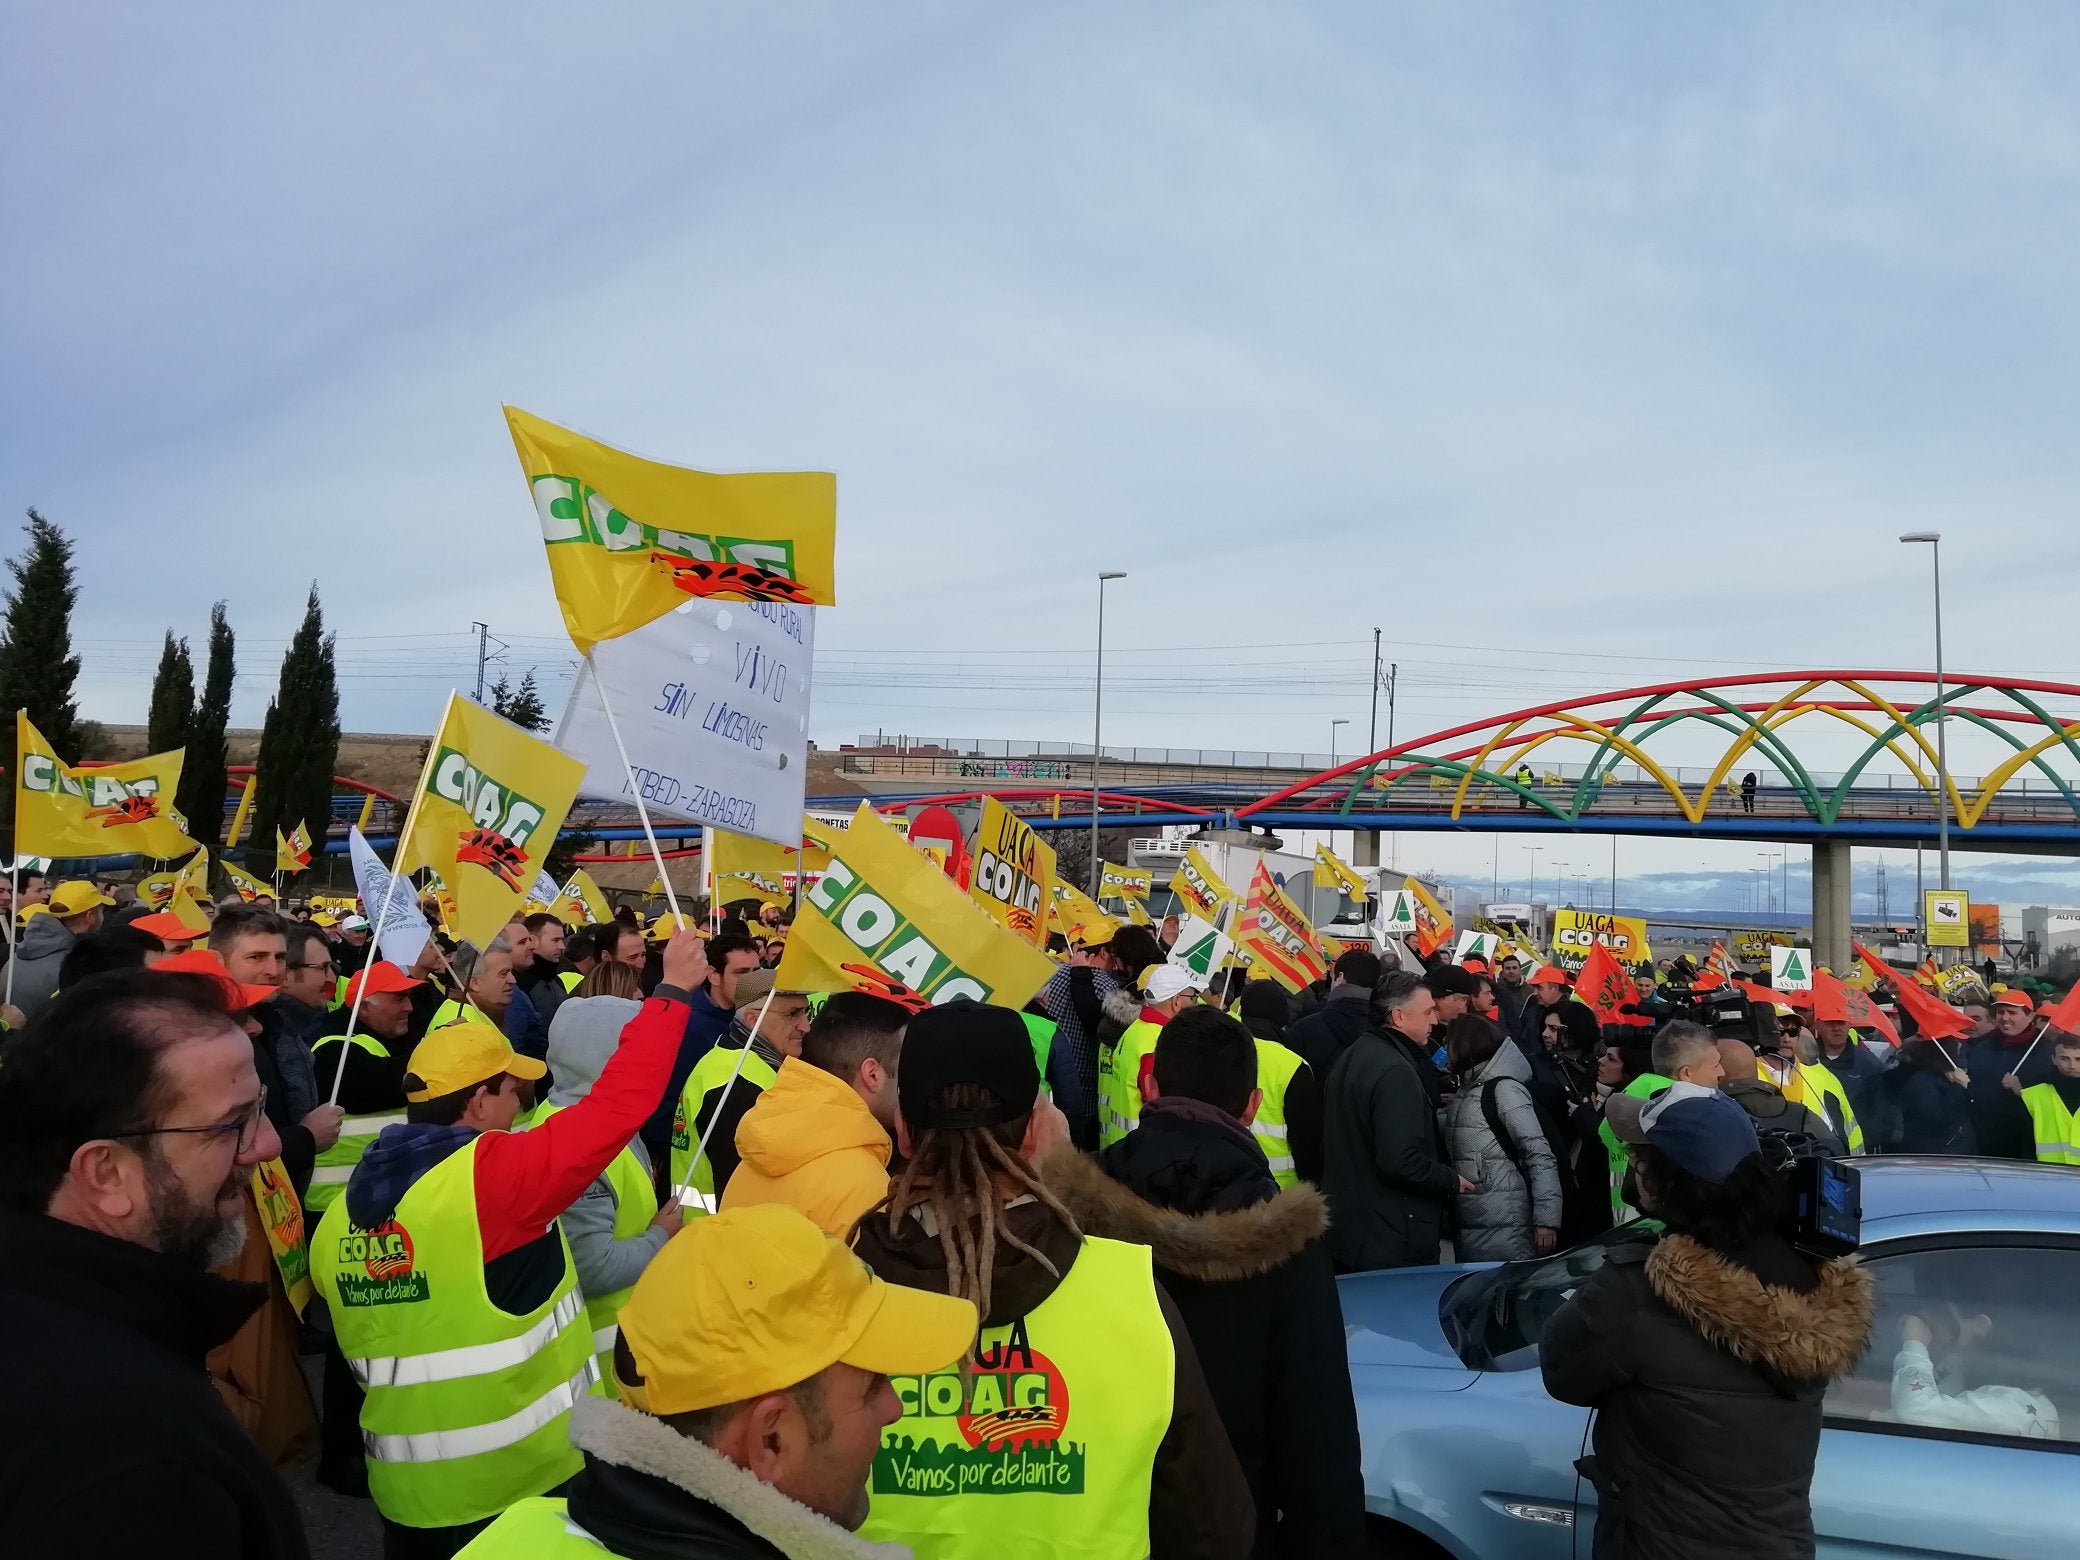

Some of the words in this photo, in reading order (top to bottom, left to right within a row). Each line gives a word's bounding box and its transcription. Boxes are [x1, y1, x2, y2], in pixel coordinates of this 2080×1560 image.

[437, 754, 541, 849] COAG
[978, 852, 1040, 917] COAG
[1180, 857, 1218, 905] COAG
[1258, 910, 1306, 955] OAG
[1560, 929, 1629, 949] COAG
[1575, 913, 1615, 933] UAGA
[1748, 933, 1775, 942] UAGA
[1779, 981, 1805, 989] ASAJA
[340, 1233, 404, 1262] COAG
[370, 1287, 384, 1306] por
[974, 1317, 1034, 1370] GA
[890, 1374, 1047, 1416] COAG
[891, 1454, 956, 1493] Vamos
[959, 1457, 993, 1495] por
[991, 1450, 1072, 1487] delante
